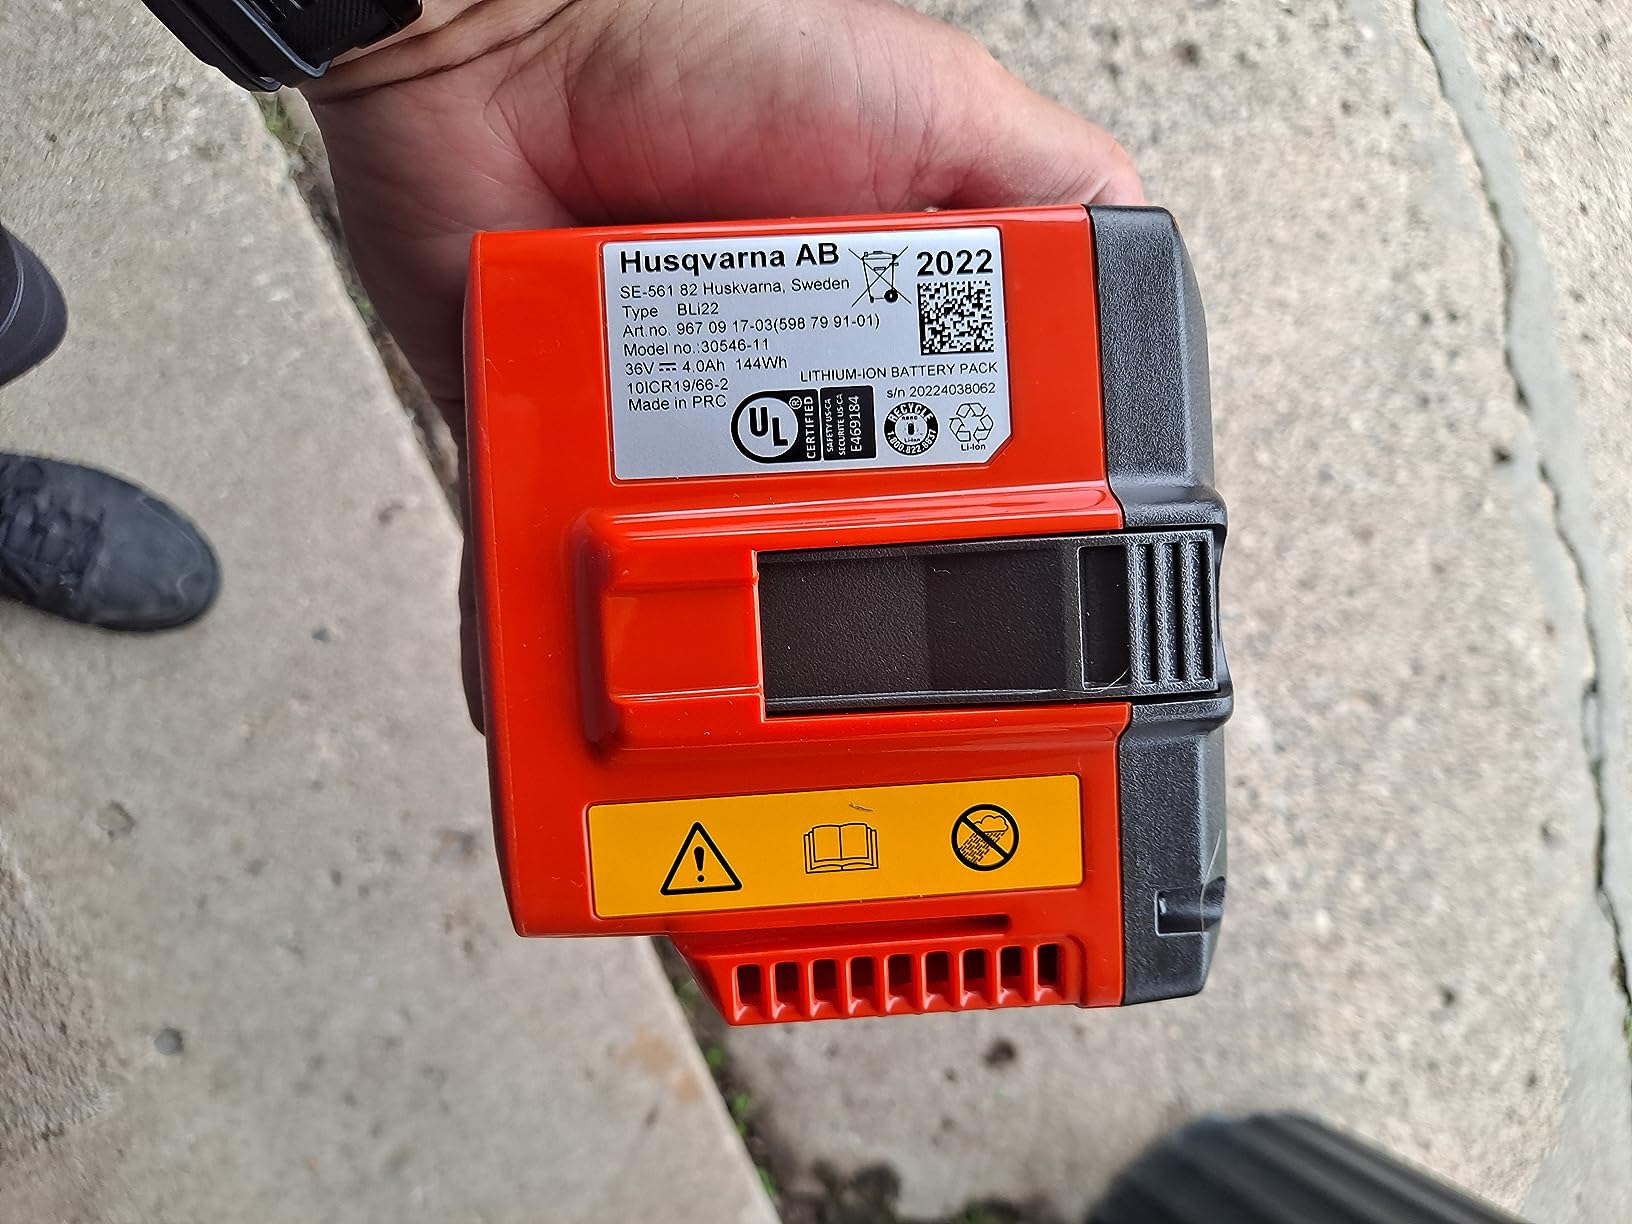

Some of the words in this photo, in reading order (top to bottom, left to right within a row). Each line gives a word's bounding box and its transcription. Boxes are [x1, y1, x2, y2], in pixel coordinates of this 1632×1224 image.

[620, 250, 786, 276] Husqvarna
[796, 243, 840, 266] AB
[916, 249, 993, 277] 2022
[620, 284, 673, 299] SE-561
[680, 283, 698, 296] 82
[703, 281, 786, 295] Huskvarna,
[791, 278, 850, 291] Sweden
[622, 305, 659, 321] Type
[677, 302, 719, 316] BLi22
[676, 322, 703, 335] 967
[708, 321, 727, 334] 09
[733, 318, 805, 335] 17-03(598
[811, 316, 828, 329] 79
[833, 314, 880, 330] 91-01)
[624, 341, 668, 356] Model
[625, 361, 654, 376] 36V
[682, 358, 725, 373] 4.0Ah
[736, 356, 788, 370] 144Wh
[800, 367, 886, 382] LITHIUM-ION
[891, 363, 956, 378] BATTERY
[960, 361, 998, 374] PACK
[627, 378, 729, 395] 10ICR19/66-2
[887, 387, 905, 398] s/n
[909, 383, 996, 397] 20224038062
[629, 398, 670, 412] Made
[674, 397, 687, 409] in
[692, 394, 727, 409] PRC
[888, 403, 934, 422] RECYCLE
[749, 406, 788, 446] UL
[804, 396, 816, 459] CERTIFIED
[848, 395, 862, 452] E469184
[825, 423, 834, 452] SAFETY
[961, 443, 986, 452] Li-Ion
